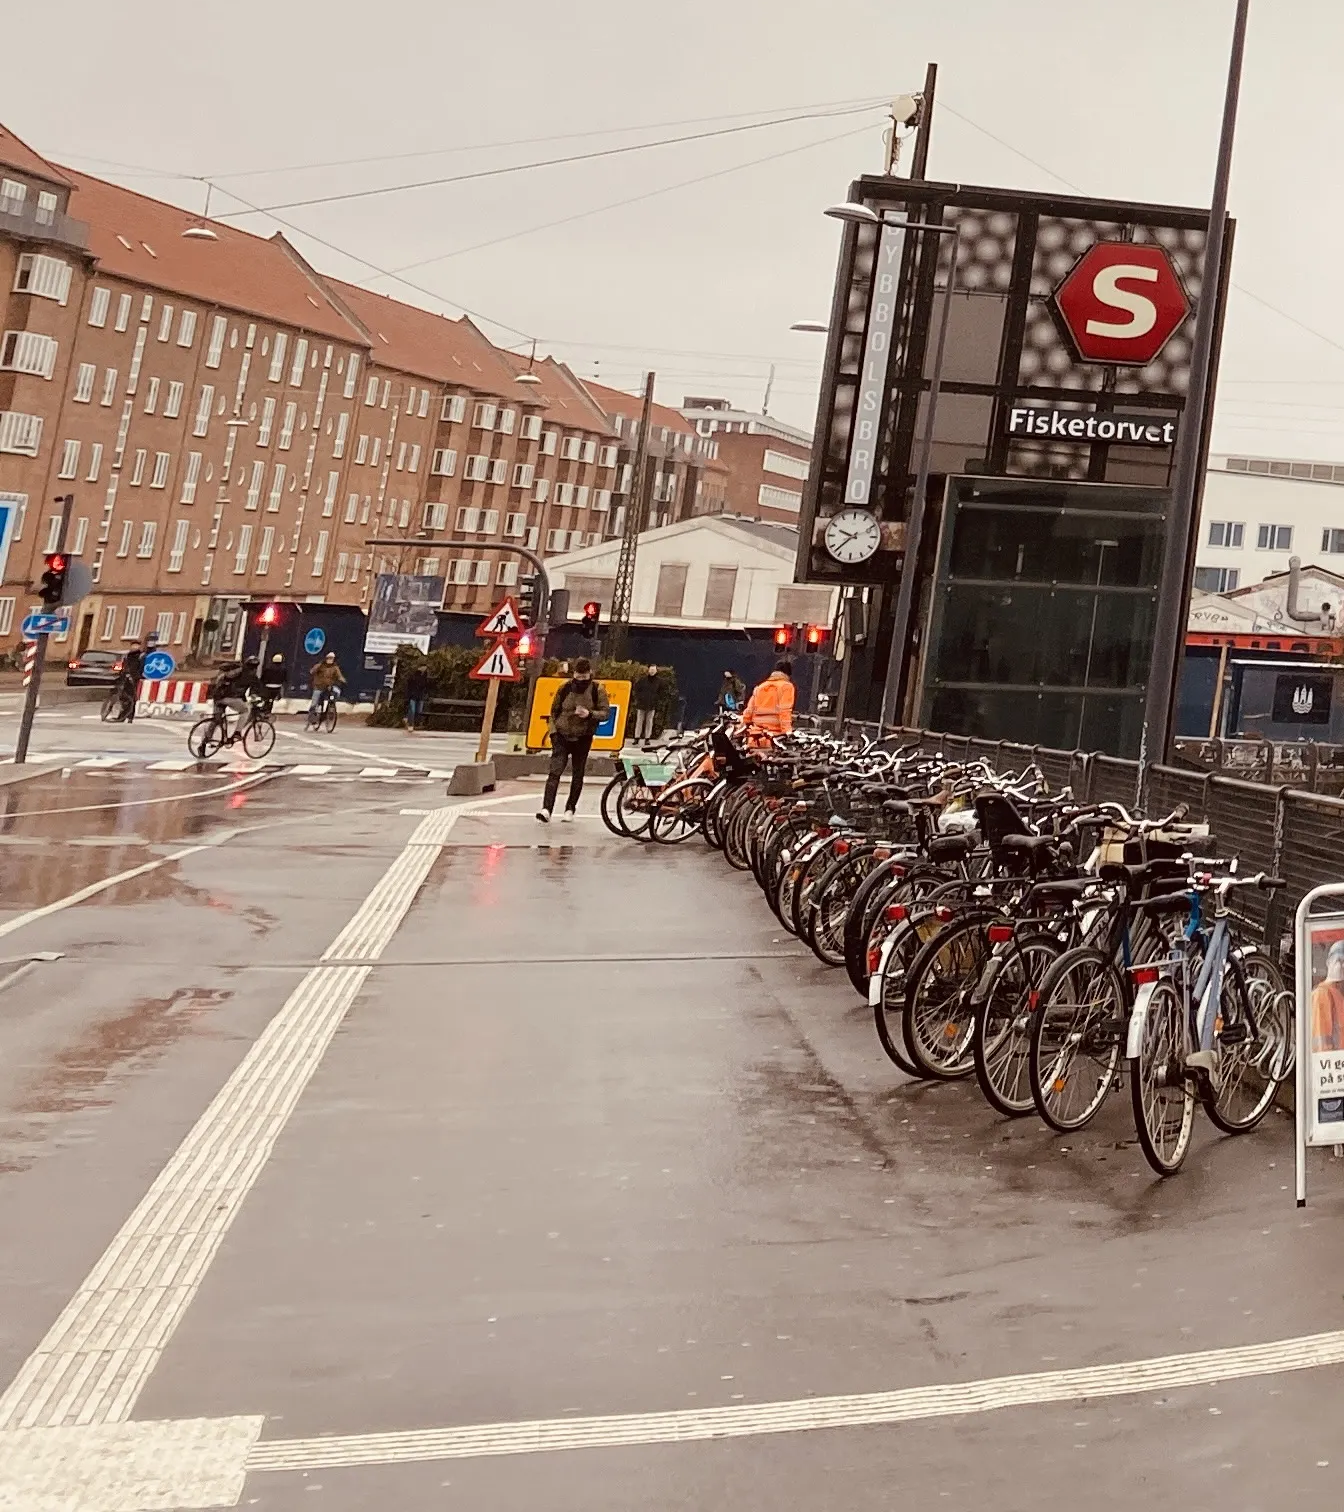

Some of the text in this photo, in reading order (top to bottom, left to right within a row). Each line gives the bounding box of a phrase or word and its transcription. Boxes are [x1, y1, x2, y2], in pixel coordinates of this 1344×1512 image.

[1085, 264, 1159, 340] S
[1009, 408, 1175, 443] Fisketorvet
[1319, 1059, 1331, 1070] Vi
[1320, 1072, 1334, 1086] på
